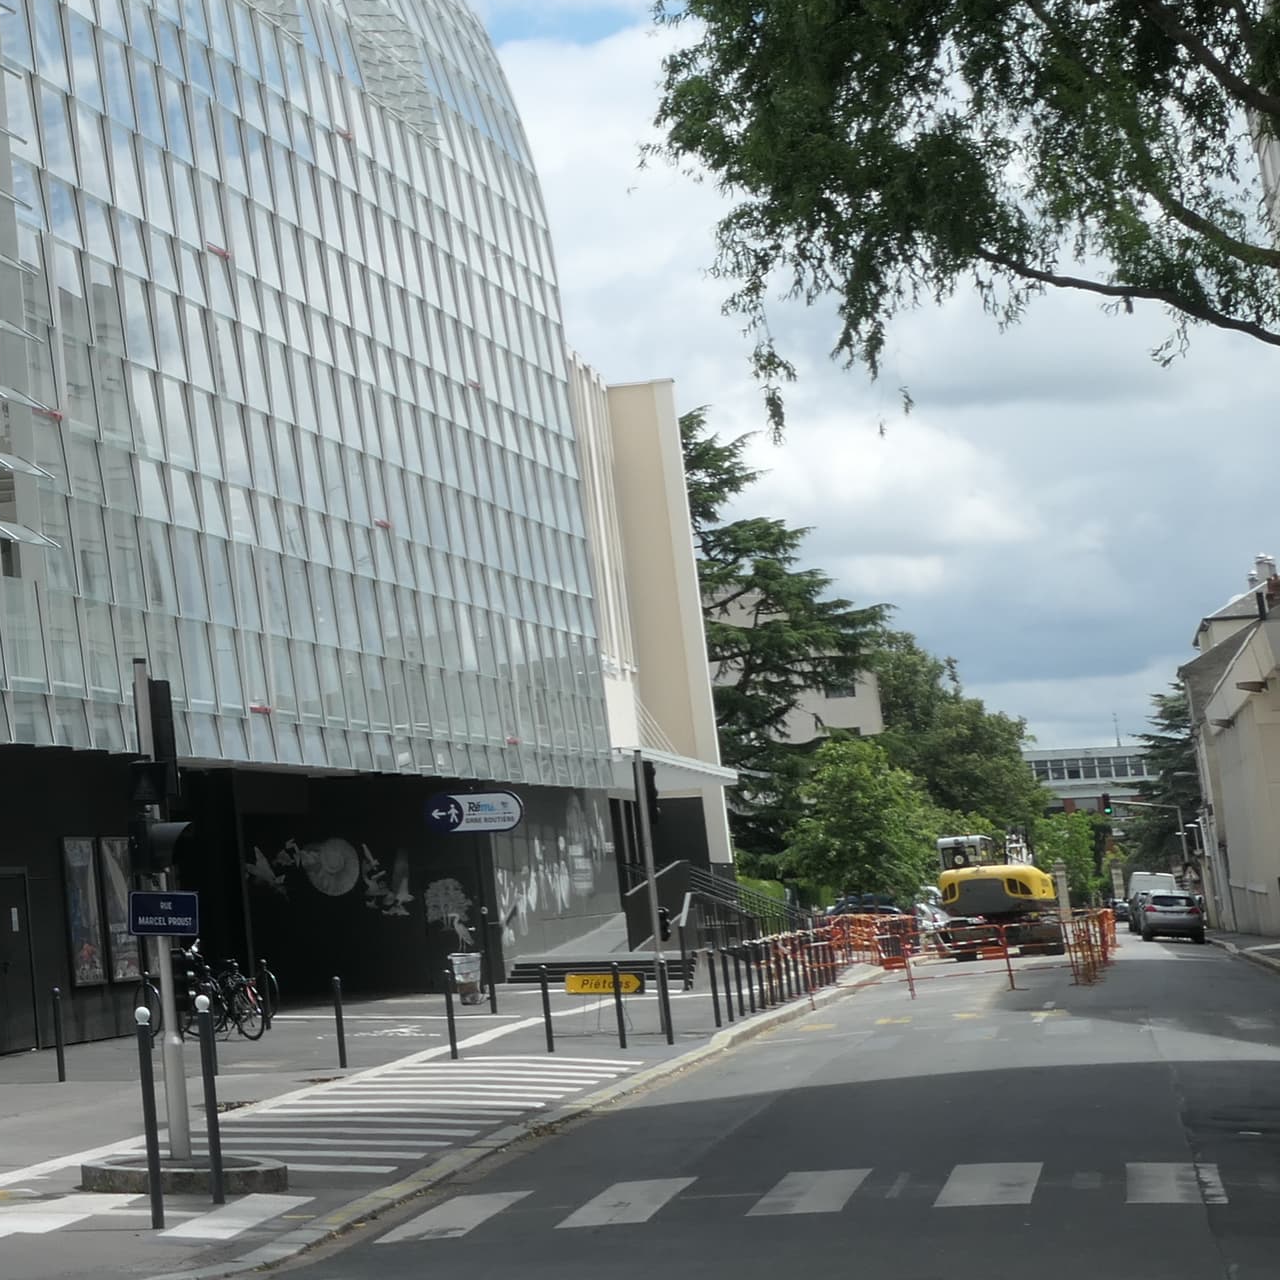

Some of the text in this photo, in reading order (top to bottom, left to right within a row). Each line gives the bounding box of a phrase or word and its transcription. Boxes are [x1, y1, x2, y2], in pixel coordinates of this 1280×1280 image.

[467, 801, 497, 812] Rémi
[160, 901, 172, 910] RUE
[138, 916, 192, 926] MARCEL PROUST
